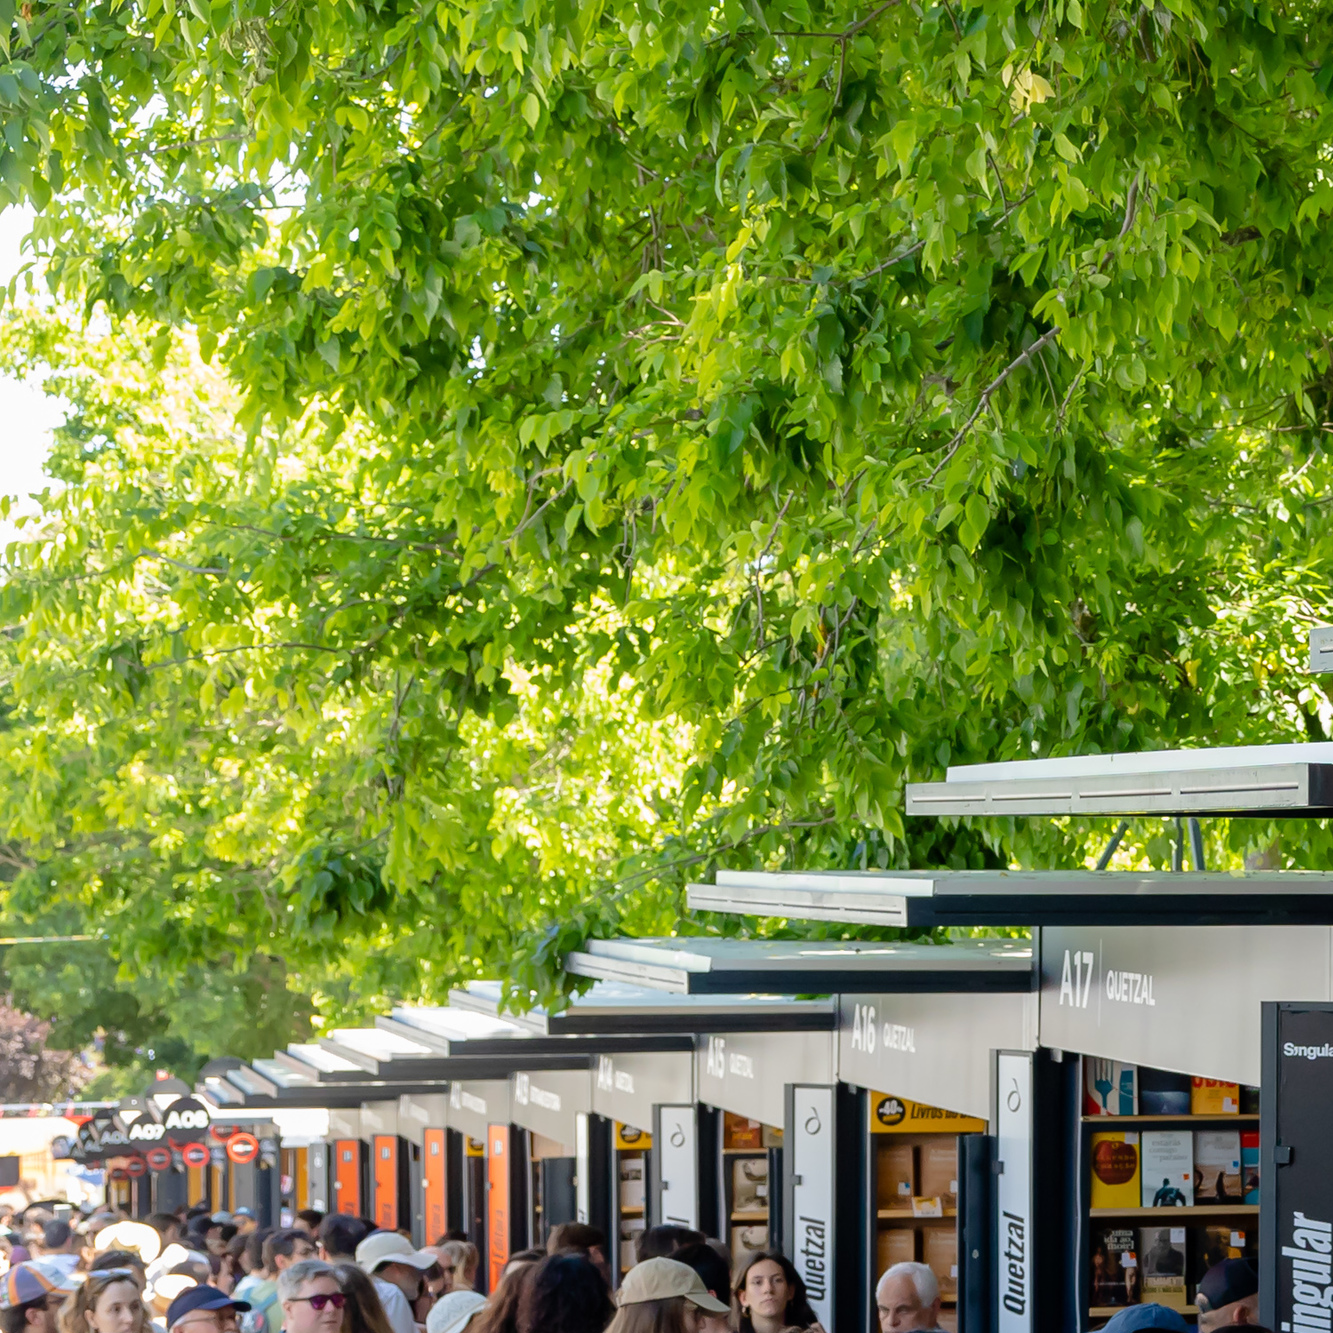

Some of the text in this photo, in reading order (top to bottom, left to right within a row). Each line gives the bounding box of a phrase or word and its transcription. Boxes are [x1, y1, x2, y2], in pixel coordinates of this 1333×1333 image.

[1059, 949, 1094, 1009] A17
[1106, 969, 1156, 1007] QUETZAL
[851, 1003, 876, 1055] A16
[129, 1123, 165, 1141] A07
[165, 1110, 209, 1130] A08
[1002, 1211, 1026, 1316] Quetzal
